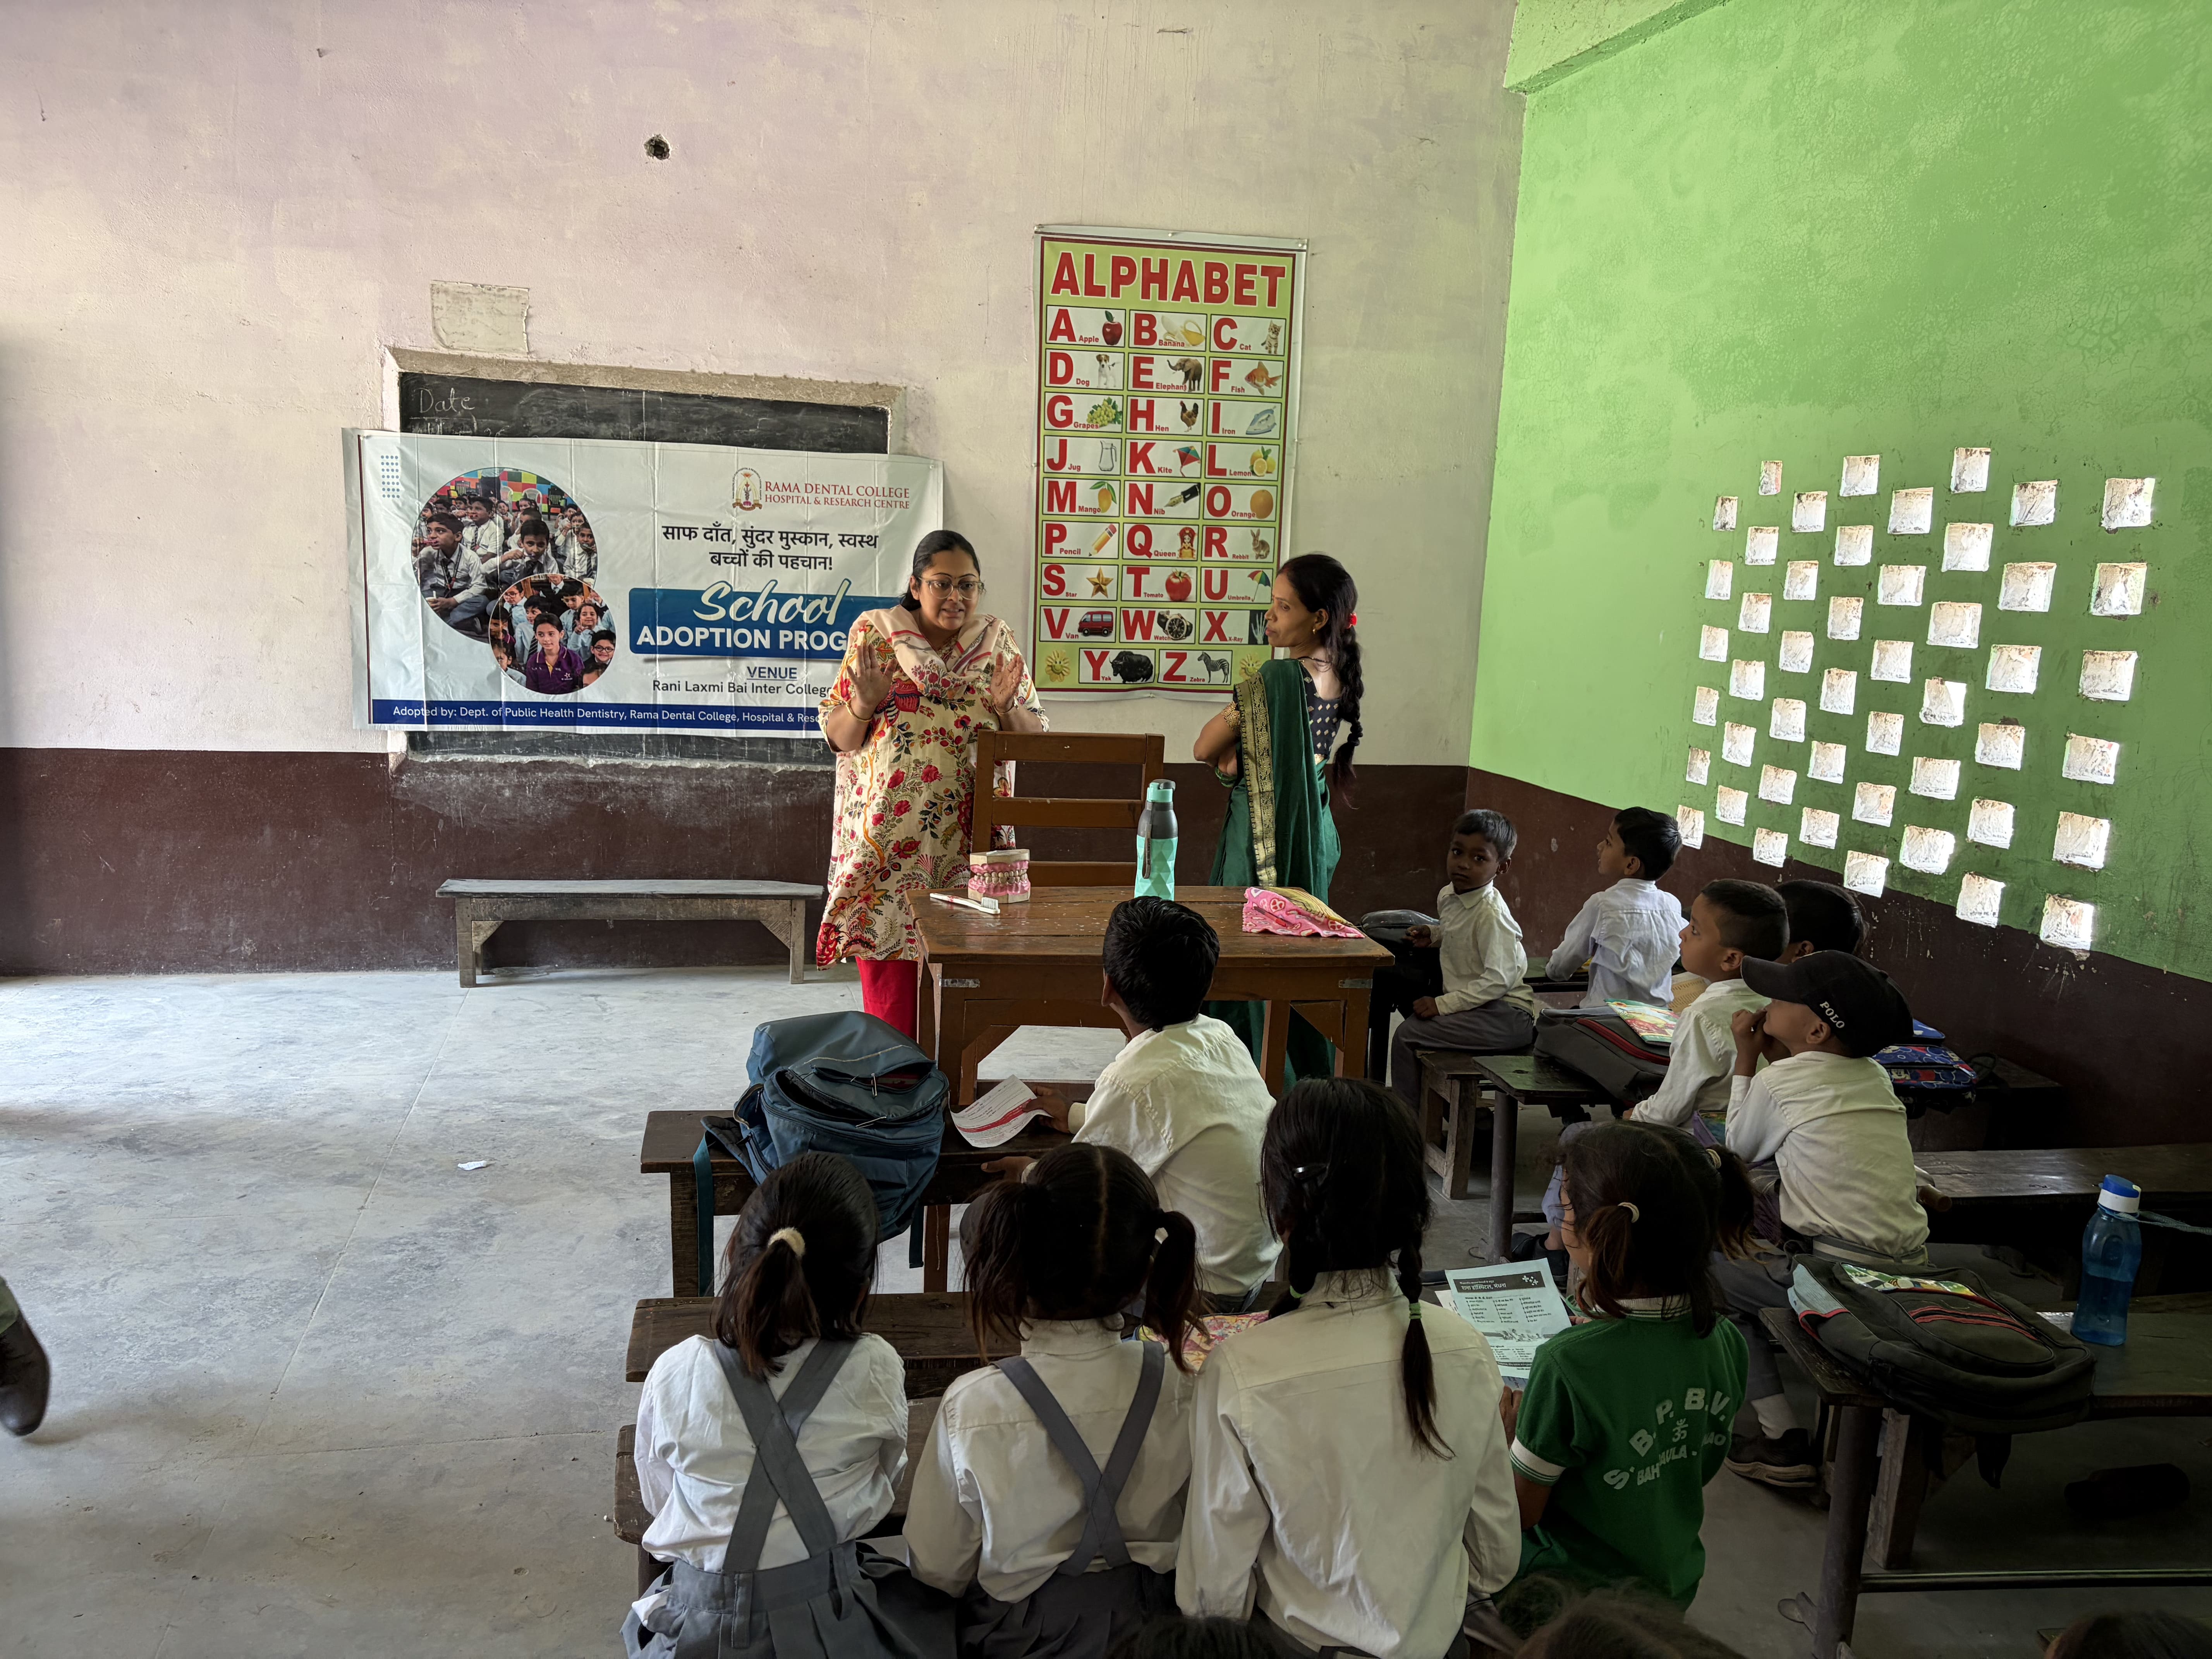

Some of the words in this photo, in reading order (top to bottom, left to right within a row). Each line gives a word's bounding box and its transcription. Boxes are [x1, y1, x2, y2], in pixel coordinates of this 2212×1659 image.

[1050, 252, 1286, 307] ALPHABET
[1049, 309, 1076, 342] A
[1079, 335, 1099, 343] Apple
[1134, 313, 1157, 346] B
[1214, 317, 1238, 350] C
[1049, 352, 1073, 385] D
[1076, 378, 1090, 387] Dog
[1133, 356, 1154, 389] E
[1211, 360, 1231, 392] F
[418, 388, 475, 414] Date
[1047, 395, 1073, 428] G
[1073, 422, 1099, 430] Grapes
[1130, 399, 1154, 431] H
[1212, 402, 1221, 434] I
[1047, 439, 1067, 471] J
[1068, 464, 1081, 472] Jug
[1130, 442, 1156, 474] K
[1207, 445, 1227, 476] L
[765, 481, 800, 495] RAMA
[804, 483, 853, 496] DENTAL
[856, 485, 910, 498] COLLEGE
[765, 495, 811, 505] HOSPITAL
[823, 497, 871, 508] RESEARCH
[874, 500, 910, 509] CENTRE
[1047, 481, 1077, 513] M
[1078, 505, 1101, 514] Mango
[1128, 483, 1154, 515] N
[1206, 486, 1231, 517] O
[1231, 511, 1256, 519] Orange
[662, 525, 698, 541] साफ
[703, 521, 736, 544] दाँत,
[741, 525, 774, 548] सुंदर
[778, 530, 833, 549] मुस्कान,
[838, 533, 879, 549] स्वस्थ
[1045, 523, 1067, 555] P
[1060, 548, 1081, 556] Pencil
[1127, 525, 1153, 559] Q
[1204, 526, 1228, 558] R
[709, 548, 749, 567] बच्चों
[752, 550, 774, 568] की
[778, 555, 833, 570] पहचान!
[1042, 564, 1066, 596] S
[1126, 567, 1150, 598] T
[1204, 570, 1228, 600] U
[694, 579, 850, 626] School
[637, 626, 771, 649] ADOPTION
[1043, 608, 1070, 639] V
[1122, 610, 1154, 640] W
[1203, 611, 1228, 642] X
[747, 666, 797, 679] VENUE
[1084, 651, 1110, 681] Y
[1163, 652, 1187, 682] Z
[653, 680, 681, 692] Rani
[685, 681, 724, 693] Laxmi
[728, 682, 747, 694] Bai
[751, 684, 782, 694] Inter
[393, 706, 437, 718] Adopted
[441, 707, 457, 718] by:
[460, 708, 488, 718] Dept.
[491, 708, 502, 717] of
[505, 708, 536, 717] Public
[540, 708, 574, 718] Health
[578, 709, 627, 721] Dentistry,
[630, 710, 658, 720] Rama
[662, 711, 695, 721] Dental
[699, 711, 739, 723] College,
[743, 713, 784, 723] Hospital
[787, 713, 794, 722] &
[1820, 1001, 1845, 1029] POLO
